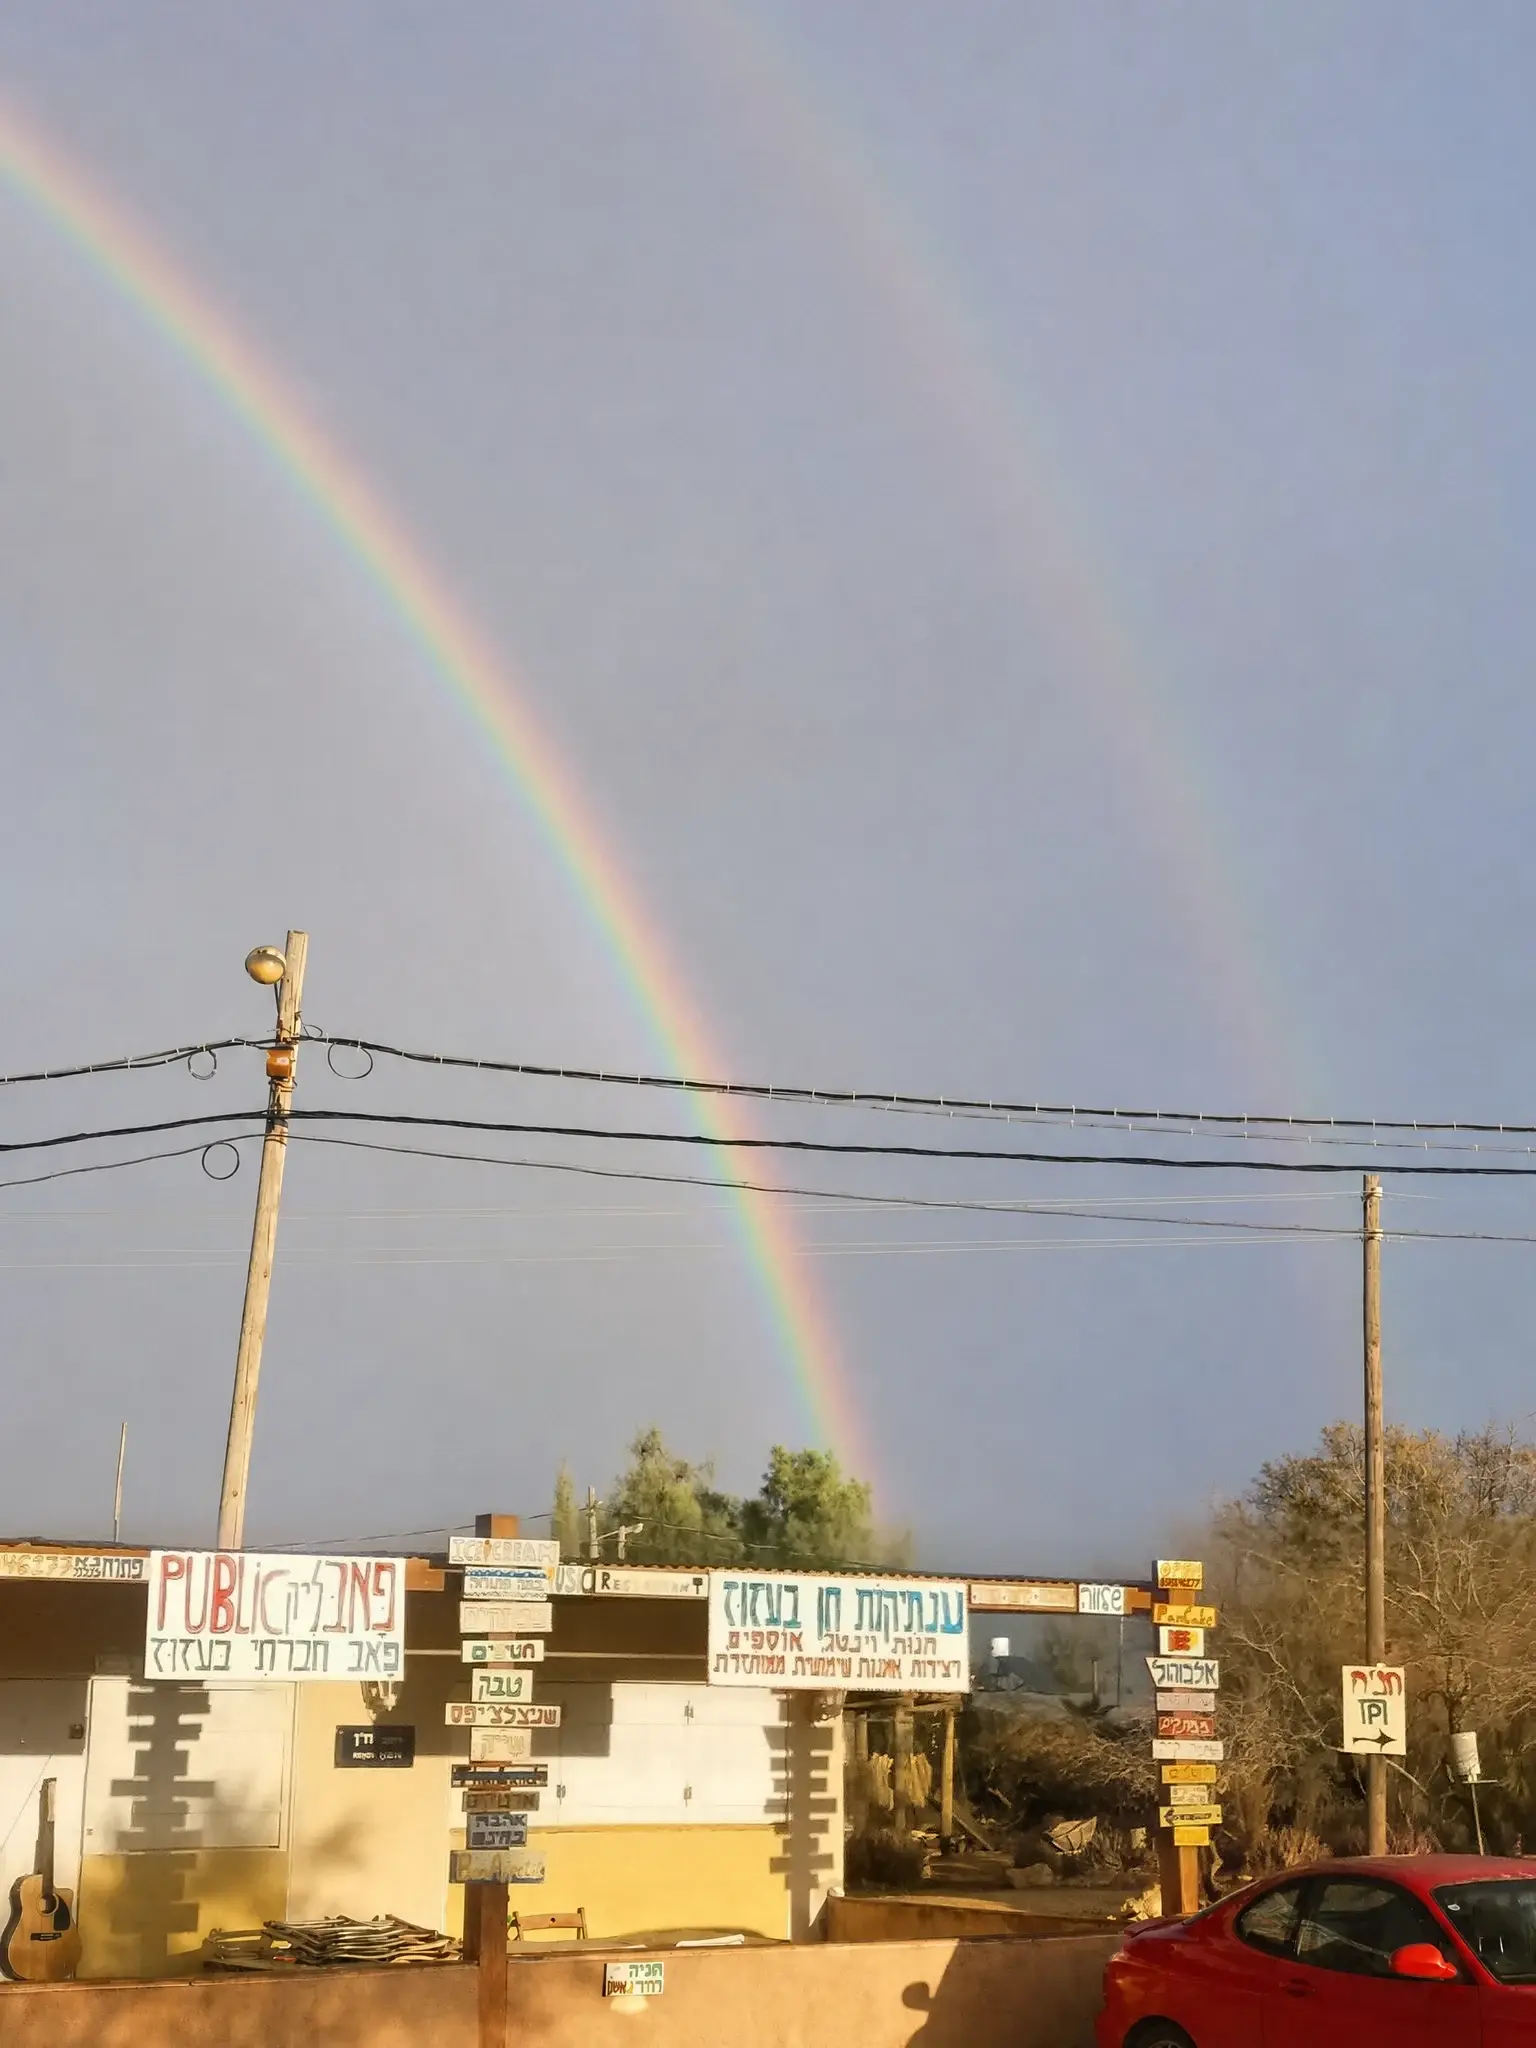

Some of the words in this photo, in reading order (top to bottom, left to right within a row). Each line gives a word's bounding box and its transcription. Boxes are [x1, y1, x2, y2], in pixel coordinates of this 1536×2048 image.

[102, 1557, 144, 1579] פתוח
[723, 1581, 801, 1629] בעזוז
[817, 1586, 842, 1640] חן
[151, 1638, 231, 1672] בעזוז
[251, 1639, 329, 1673] חברתי
[347, 1641, 400, 1673] פאב
[891, 1635, 938, 1655] חנות
[1152, 1659, 1217, 1685] אלכוהול
[479, 1676, 523, 1700] טבק
[475, 1814, 526, 1828] אהבה
[472, 1830, 526, 1846] בחינם
